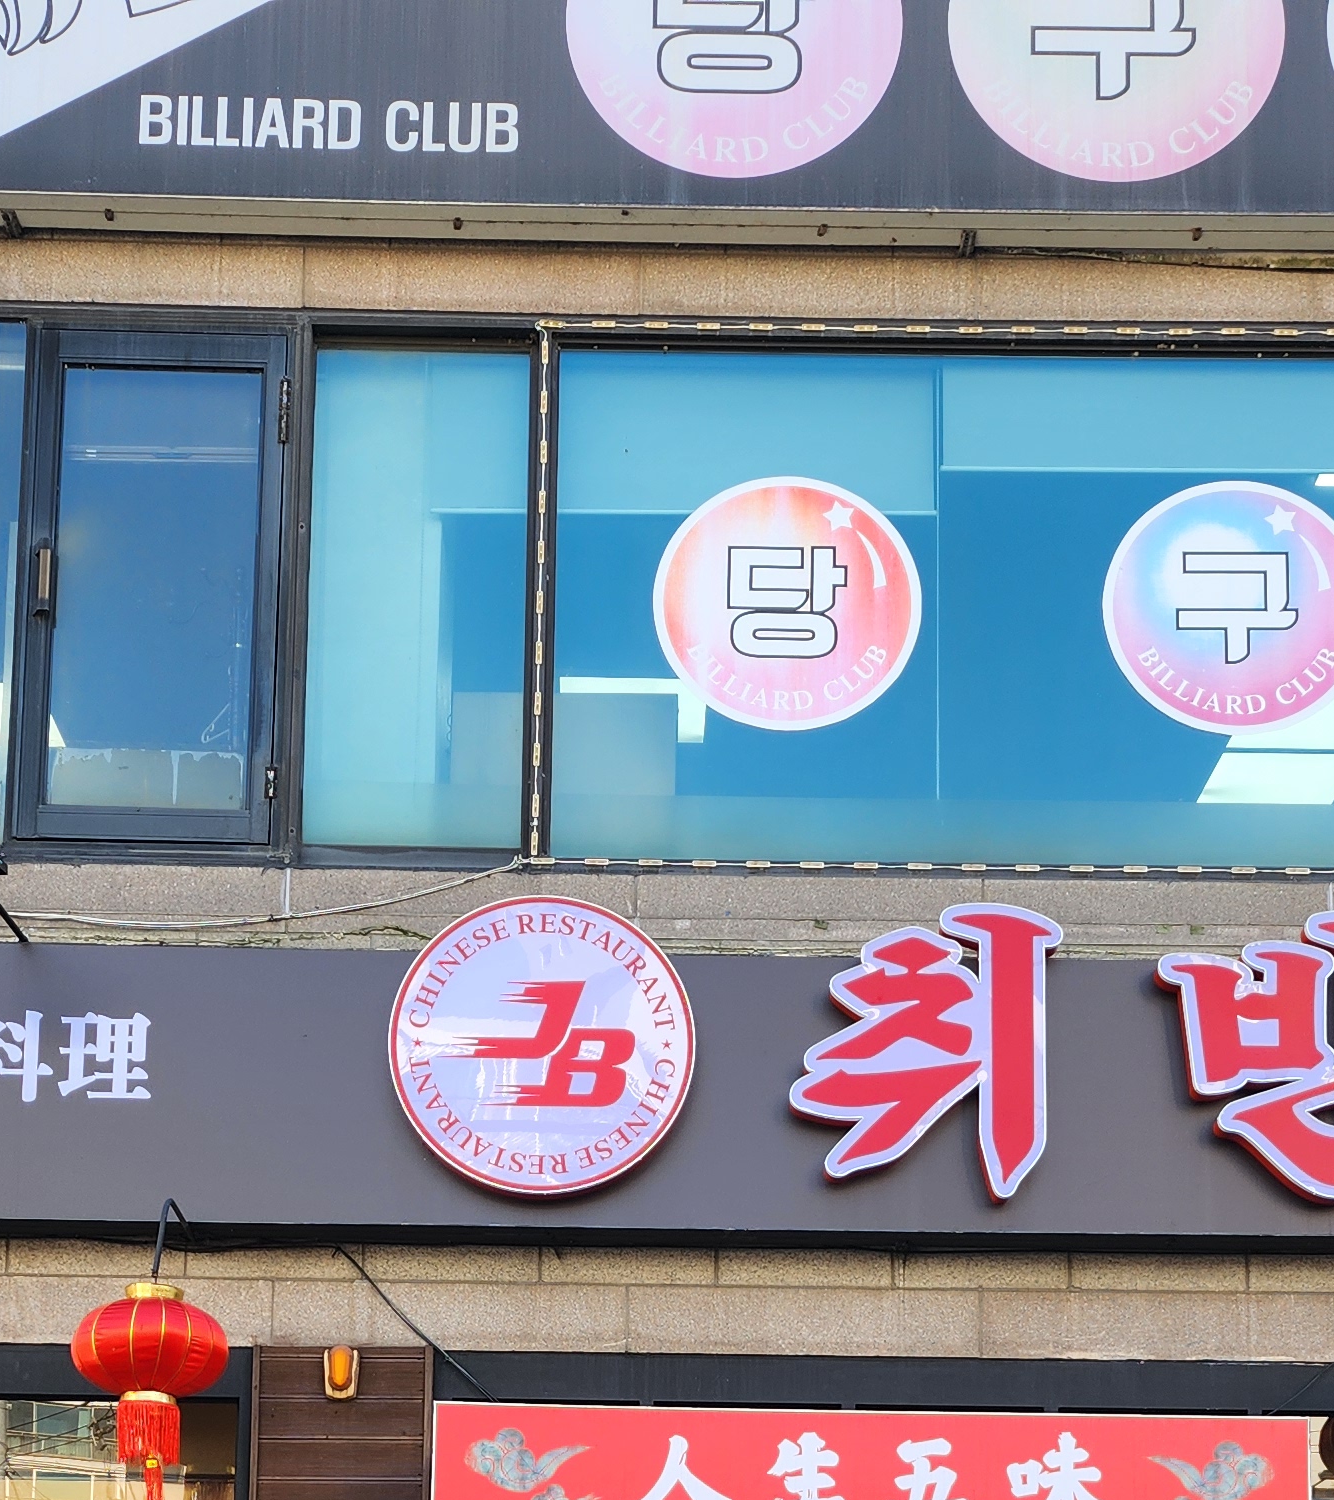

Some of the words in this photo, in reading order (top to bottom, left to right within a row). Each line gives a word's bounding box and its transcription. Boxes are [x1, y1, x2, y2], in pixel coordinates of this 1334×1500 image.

[139, 94, 361, 150] BILLIARD
[385, 99, 519, 154] CLUB
[598, 72, 769, 163] BILLIARD
[782, 74, 869, 151] CLUB
[983, 79, 1156, 168] BILLIARD
[1169, 79, 1254, 157] CLUB
[685, 640, 815, 711] BILLIARD
[822, 641, 888, 703] CLUB
[1135, 645, 1267, 717] BILLIARD
[408, 918, 511, 1029] CHINESE
[516, 913, 677, 1032] RESTAURANT
[412, 1056, 570, 1176] RESTAURANT
[575, 1058, 677, 1170] CHINESE
